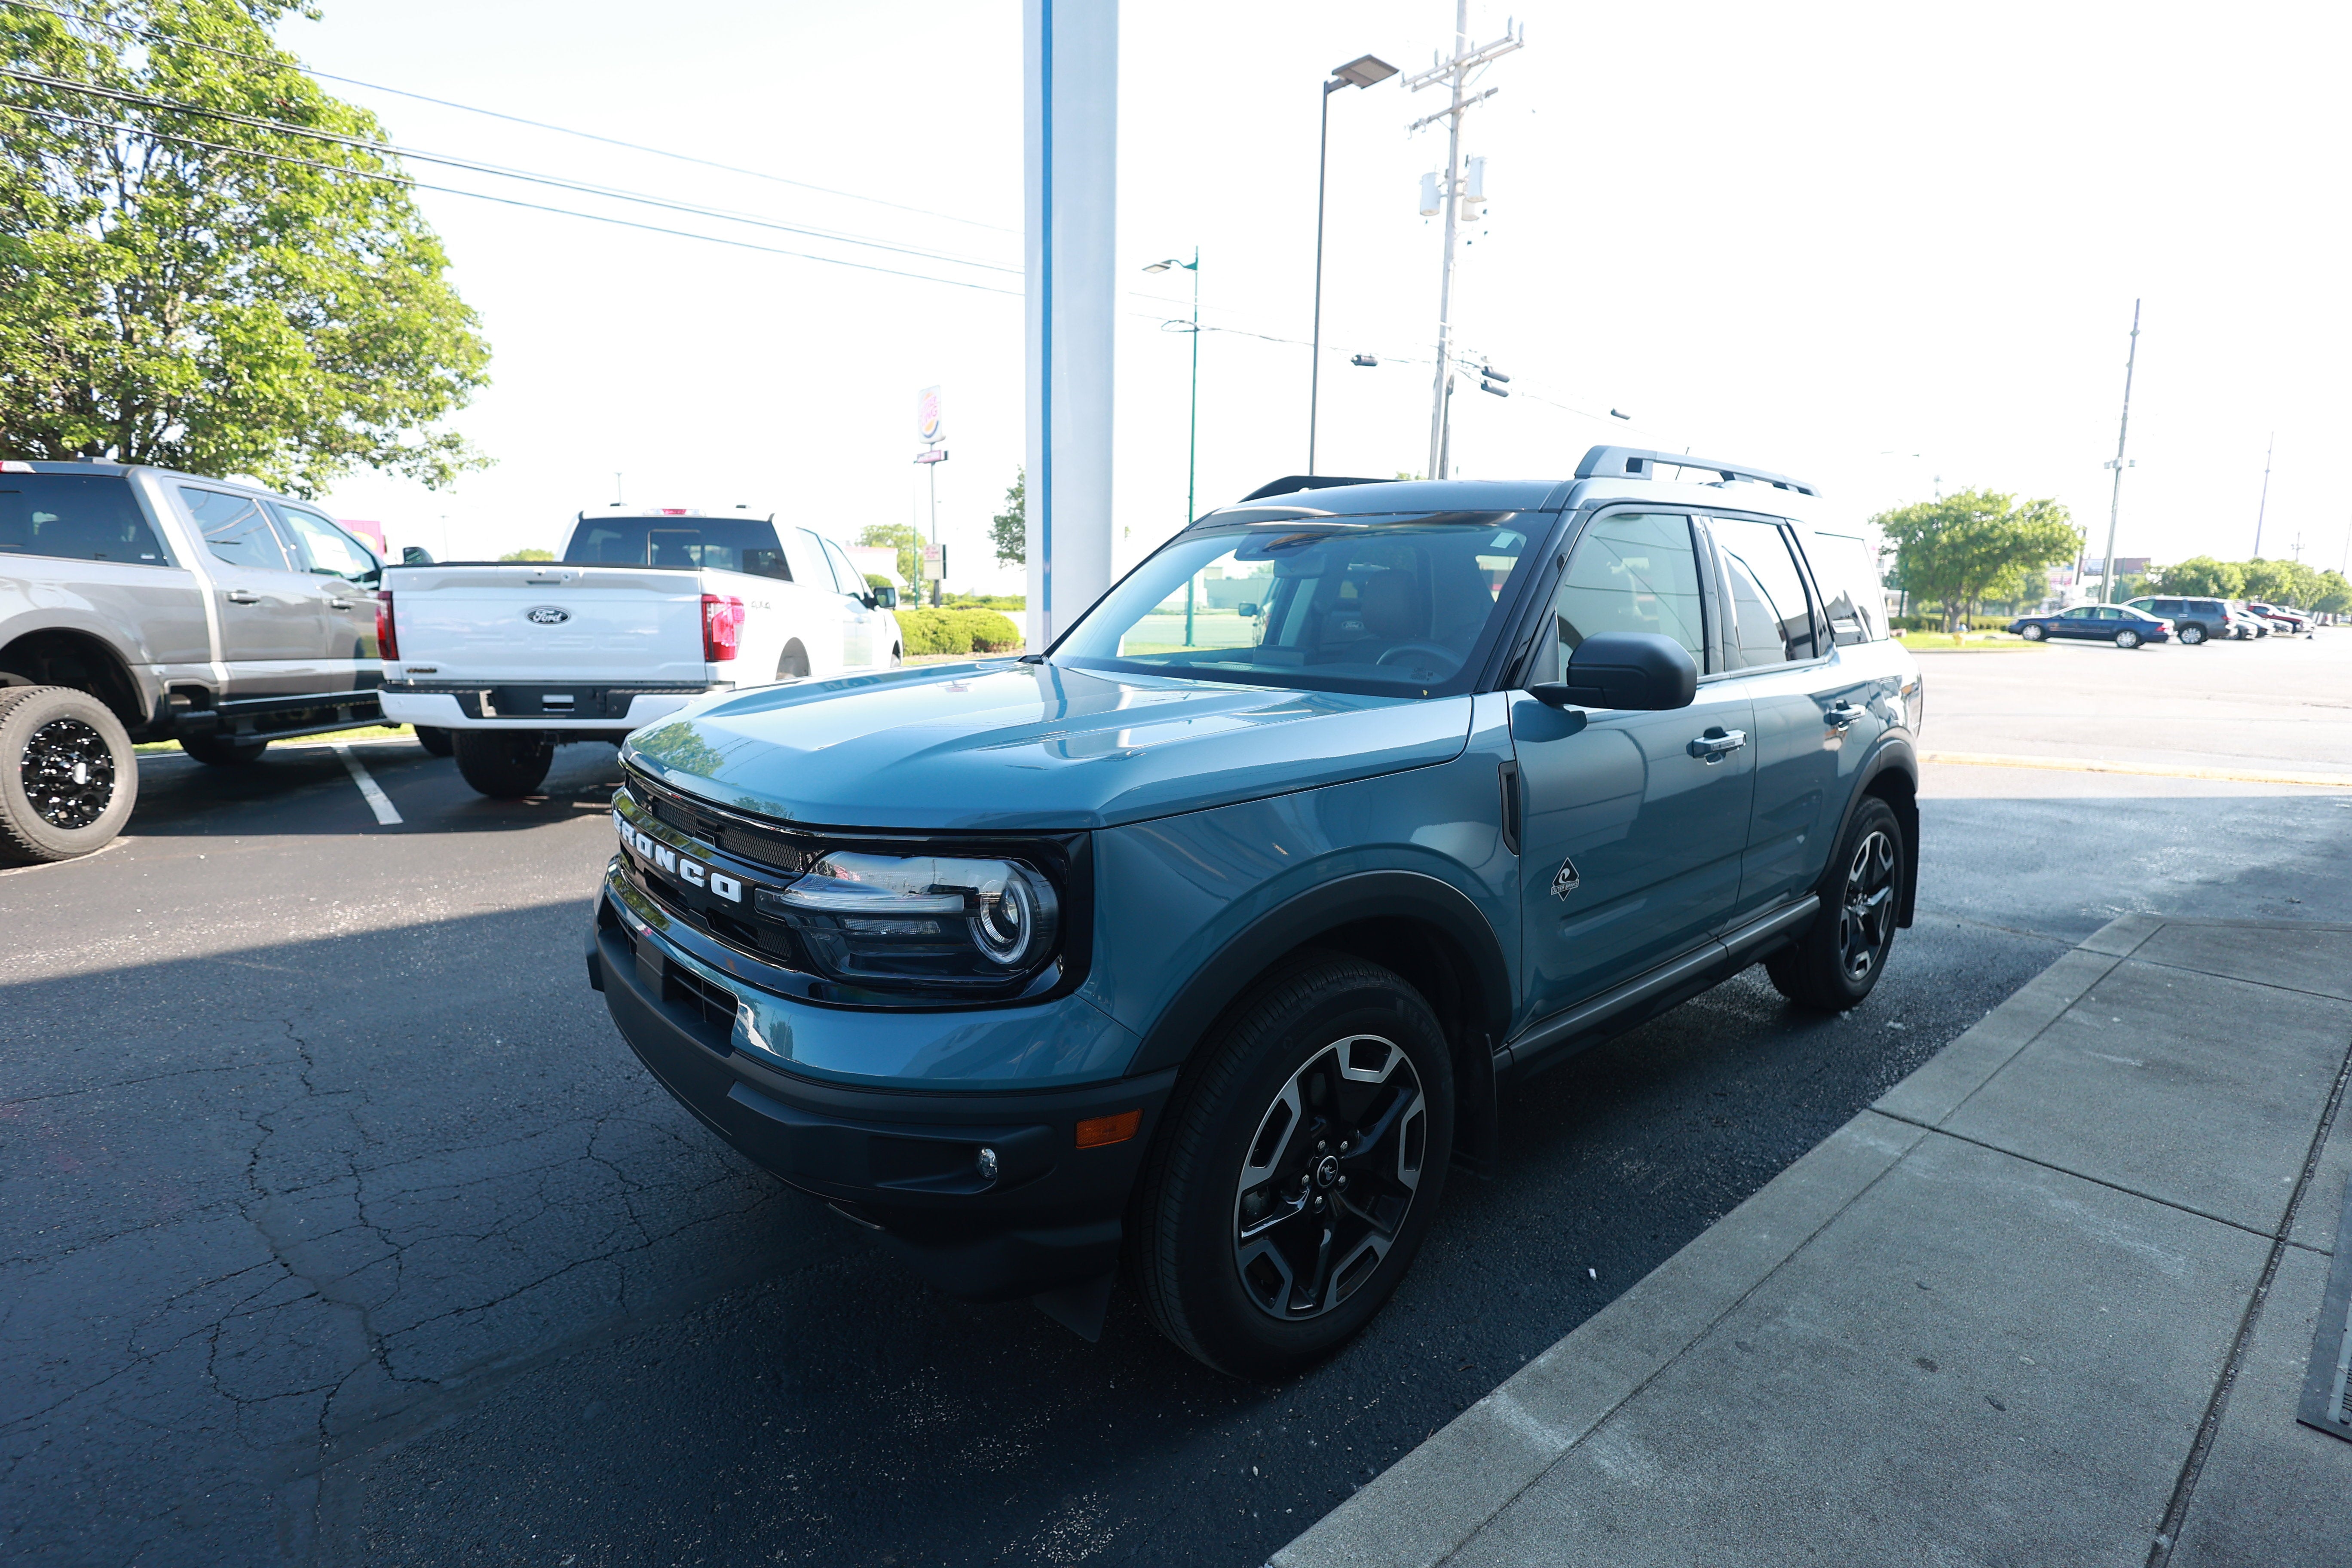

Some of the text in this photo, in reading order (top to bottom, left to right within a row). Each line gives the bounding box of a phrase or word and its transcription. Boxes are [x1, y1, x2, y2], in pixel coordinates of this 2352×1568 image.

[533, 609, 562, 622] Ford
[453, 631, 649, 651] F-150
[612, 809, 742, 903] BRONCO
[1552, 881, 1578, 893] OUTER BANKS
